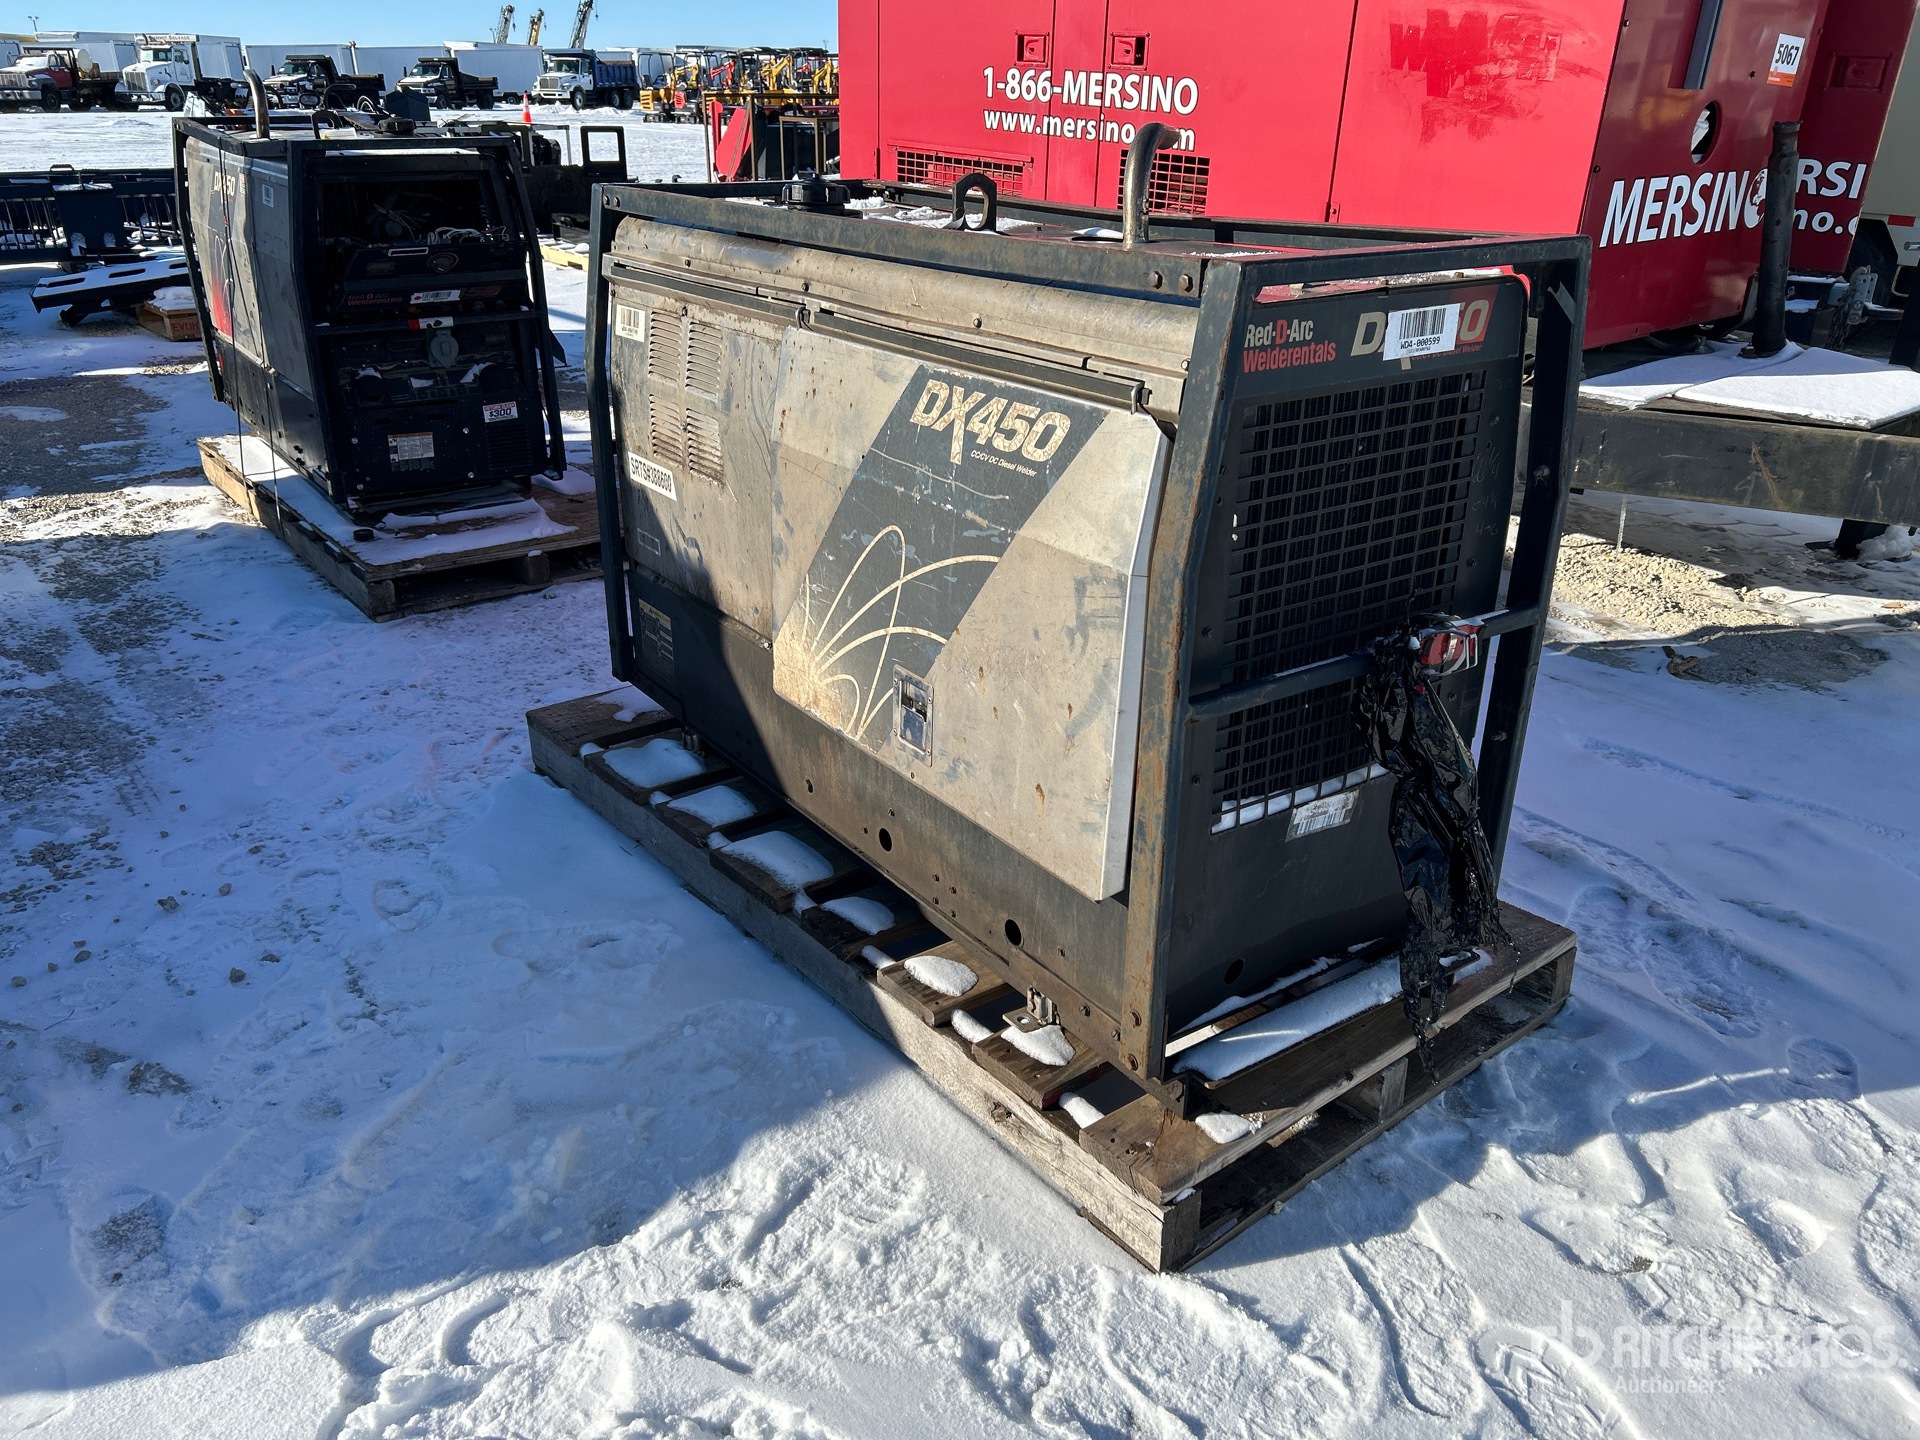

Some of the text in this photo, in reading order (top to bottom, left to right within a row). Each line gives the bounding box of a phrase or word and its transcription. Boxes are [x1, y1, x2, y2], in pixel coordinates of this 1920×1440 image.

[1775, 44, 1800, 66] 5067
[982, 65, 1199, 116] 1-866-MERSINO
[983, 109, 1196, 151] www.mersinom
[1796, 158, 1867, 199] RSI
[1243, 340, 1336, 373] Welderentals
[1400, 336, 1441, 350] WD4-000599
[489, 407, 512, 418] $300
[909, 379, 1071, 465] DX450
[988, 456, 999, 466] DC
[999, 459, 1017, 472] Diesel
[1016, 464, 1037, 477] Welder
